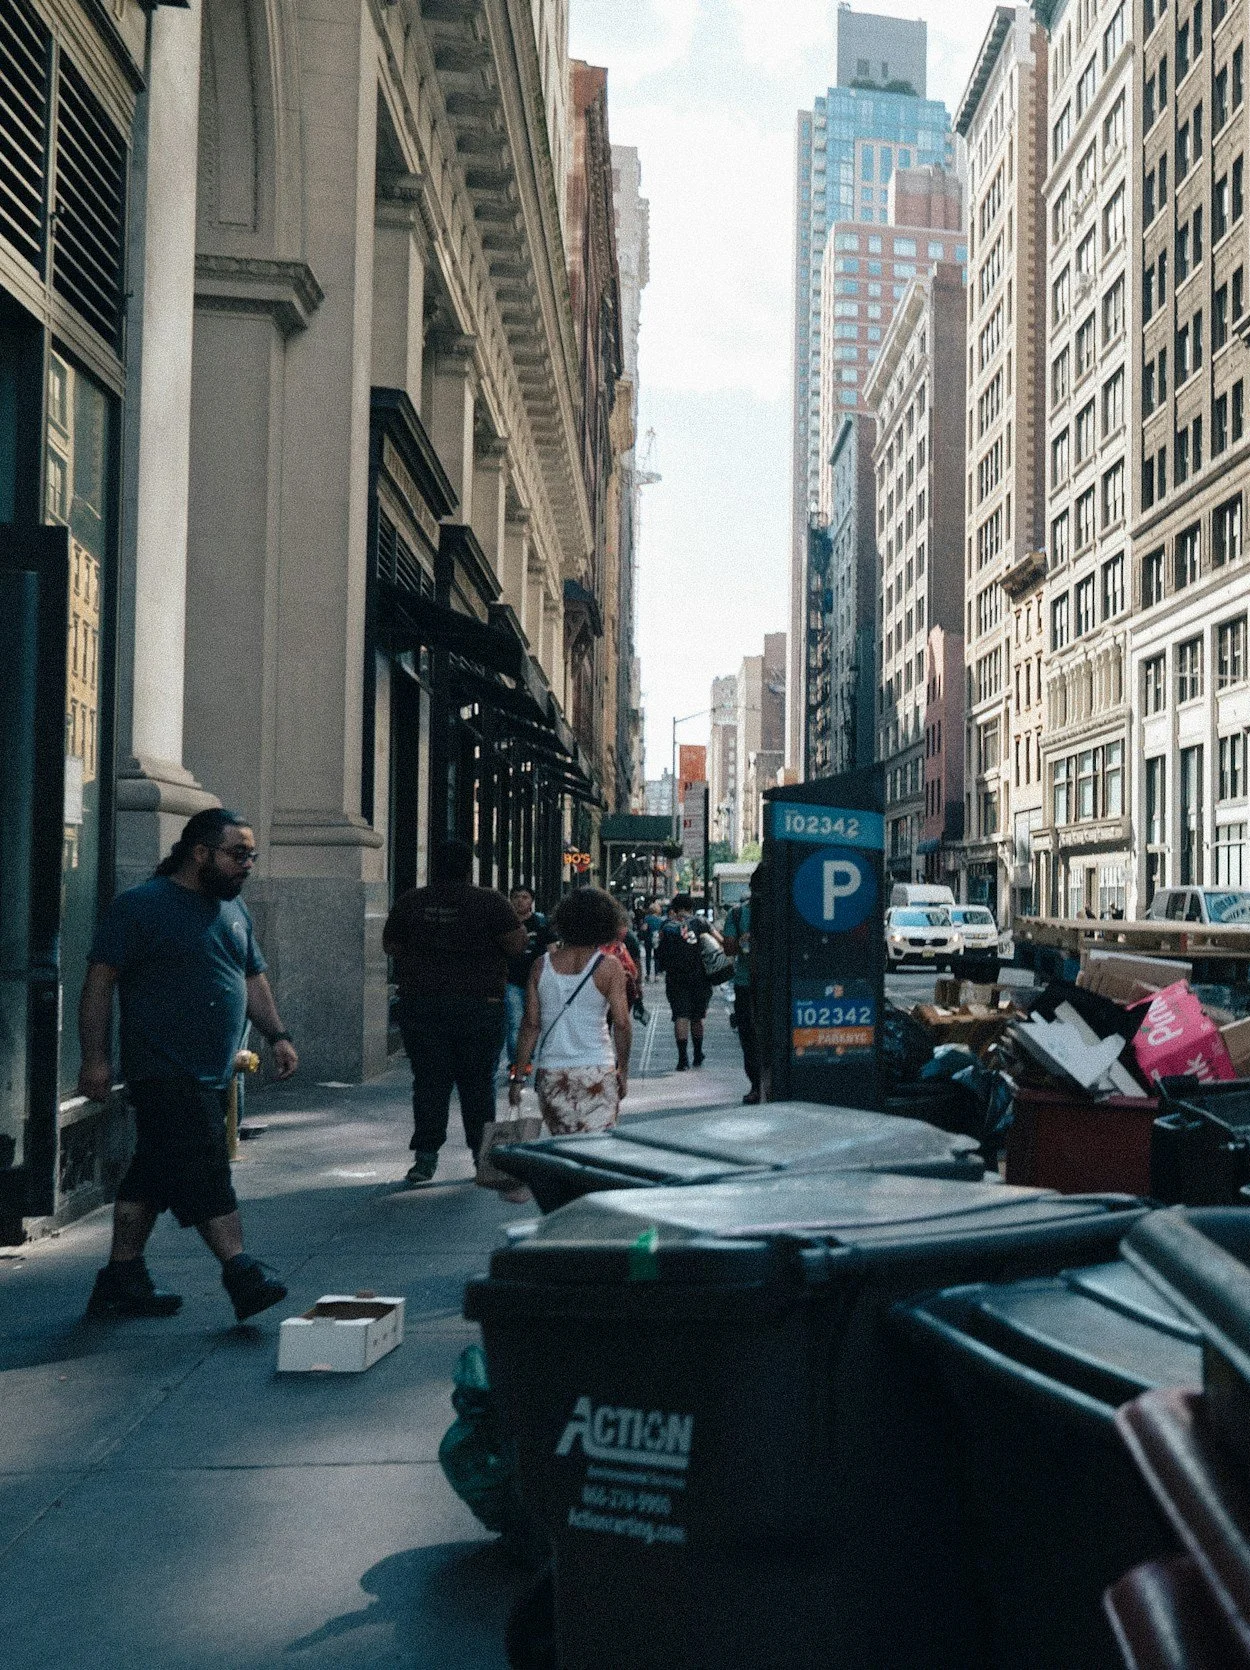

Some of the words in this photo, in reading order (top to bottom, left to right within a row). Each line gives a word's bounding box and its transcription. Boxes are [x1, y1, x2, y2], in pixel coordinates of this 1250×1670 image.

[784, 814, 859, 839] 102342
[823, 860, 862, 920] P
[797, 1006, 871, 1026] 102342
[555, 1396, 693, 1465] ACTION
